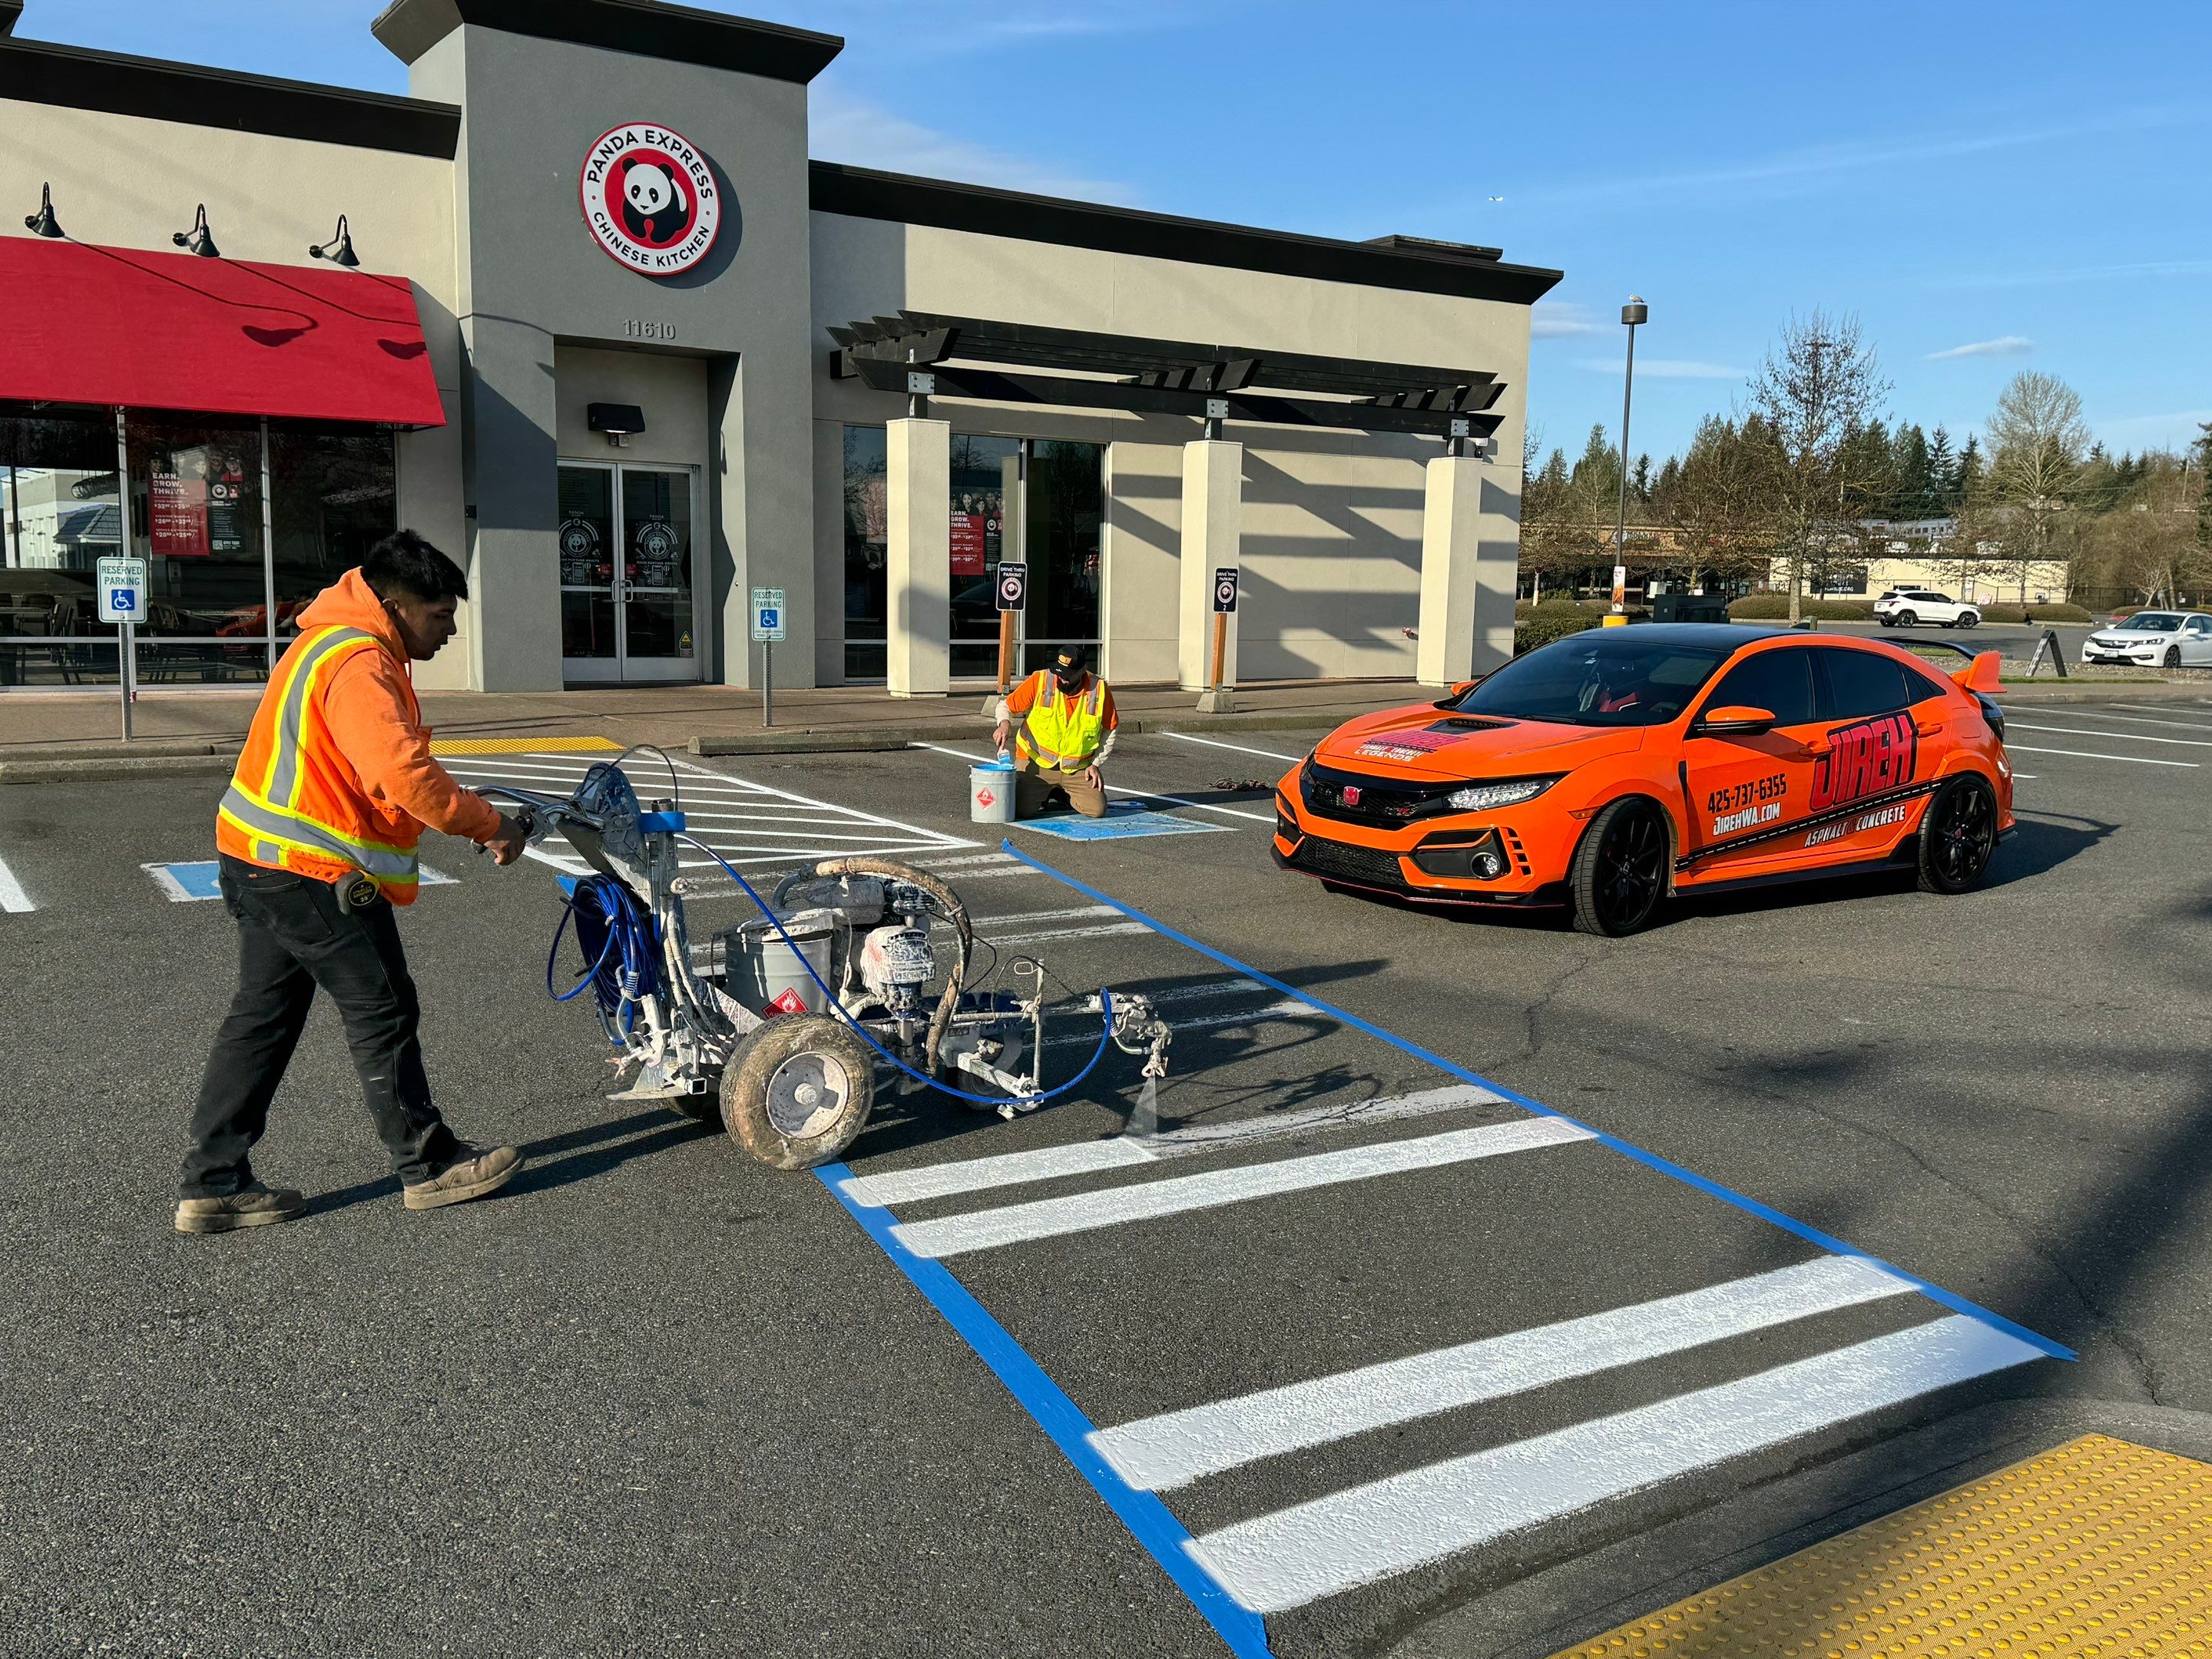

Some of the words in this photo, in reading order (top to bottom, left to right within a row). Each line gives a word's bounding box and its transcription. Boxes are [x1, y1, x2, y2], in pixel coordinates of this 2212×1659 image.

[588, 131, 638, 184] PANDA
[645, 130, 713, 199] EXPRESS
[594, 212, 649, 265] CHINESE
[656, 226, 710, 267] KITCHEN
[623, 319, 676, 339] 11610
[101, 566, 143, 575] RESERVED
[104, 577, 140, 585] PARKING
[1353, 748, 1416, 763] LEGENDS
[1810, 710, 1917, 811] JIREH
[1708, 773, 1787, 813] 425-737-6355
[1803, 821, 1849, 848] ASPHALT
[1856, 804, 1906, 832] CONCRETE
